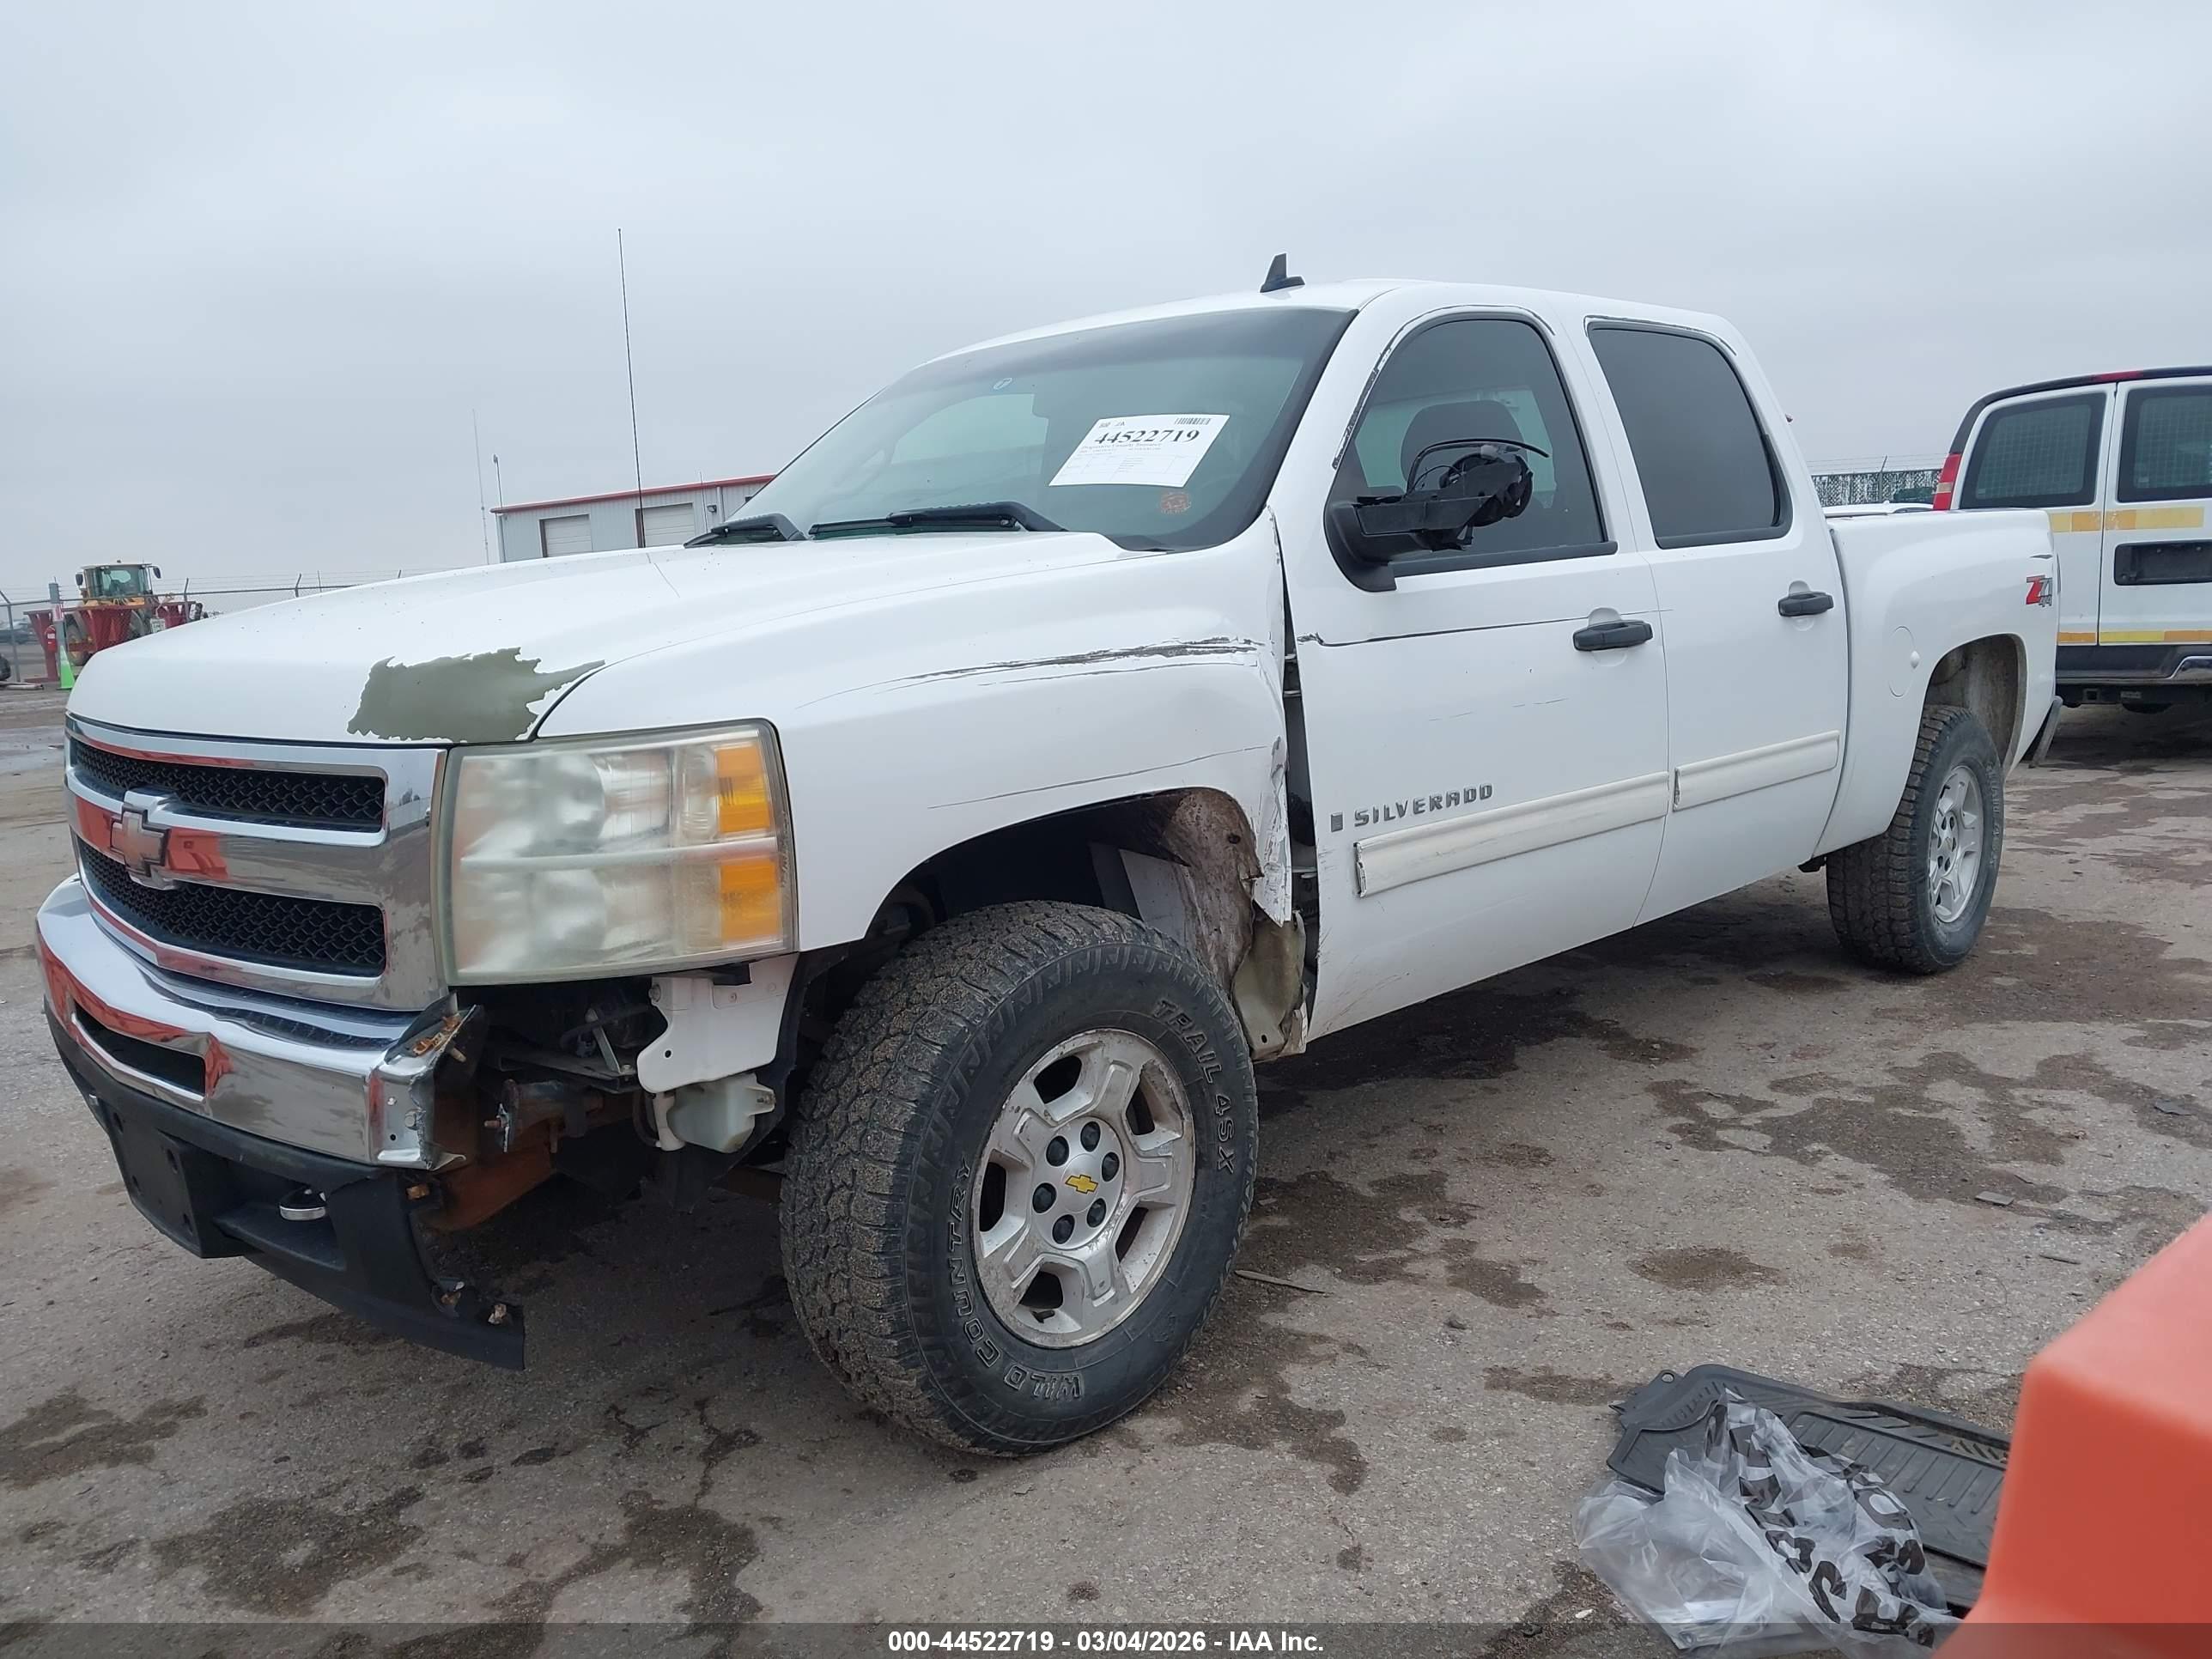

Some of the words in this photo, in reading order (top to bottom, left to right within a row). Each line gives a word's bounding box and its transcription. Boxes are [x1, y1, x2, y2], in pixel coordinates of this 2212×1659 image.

[1095, 429, 1200, 444] 44522719
[2026, 574, 2053, 605] Z71
[1354, 783, 1492, 826] SILVERADO
[1152, 999, 1223, 1085] TRAIL
[1214, 1092, 1236, 1175] 4SX
[948, 1157, 1001, 1368] COUNTRY
[1003, 1364, 1084, 1402] WILD
